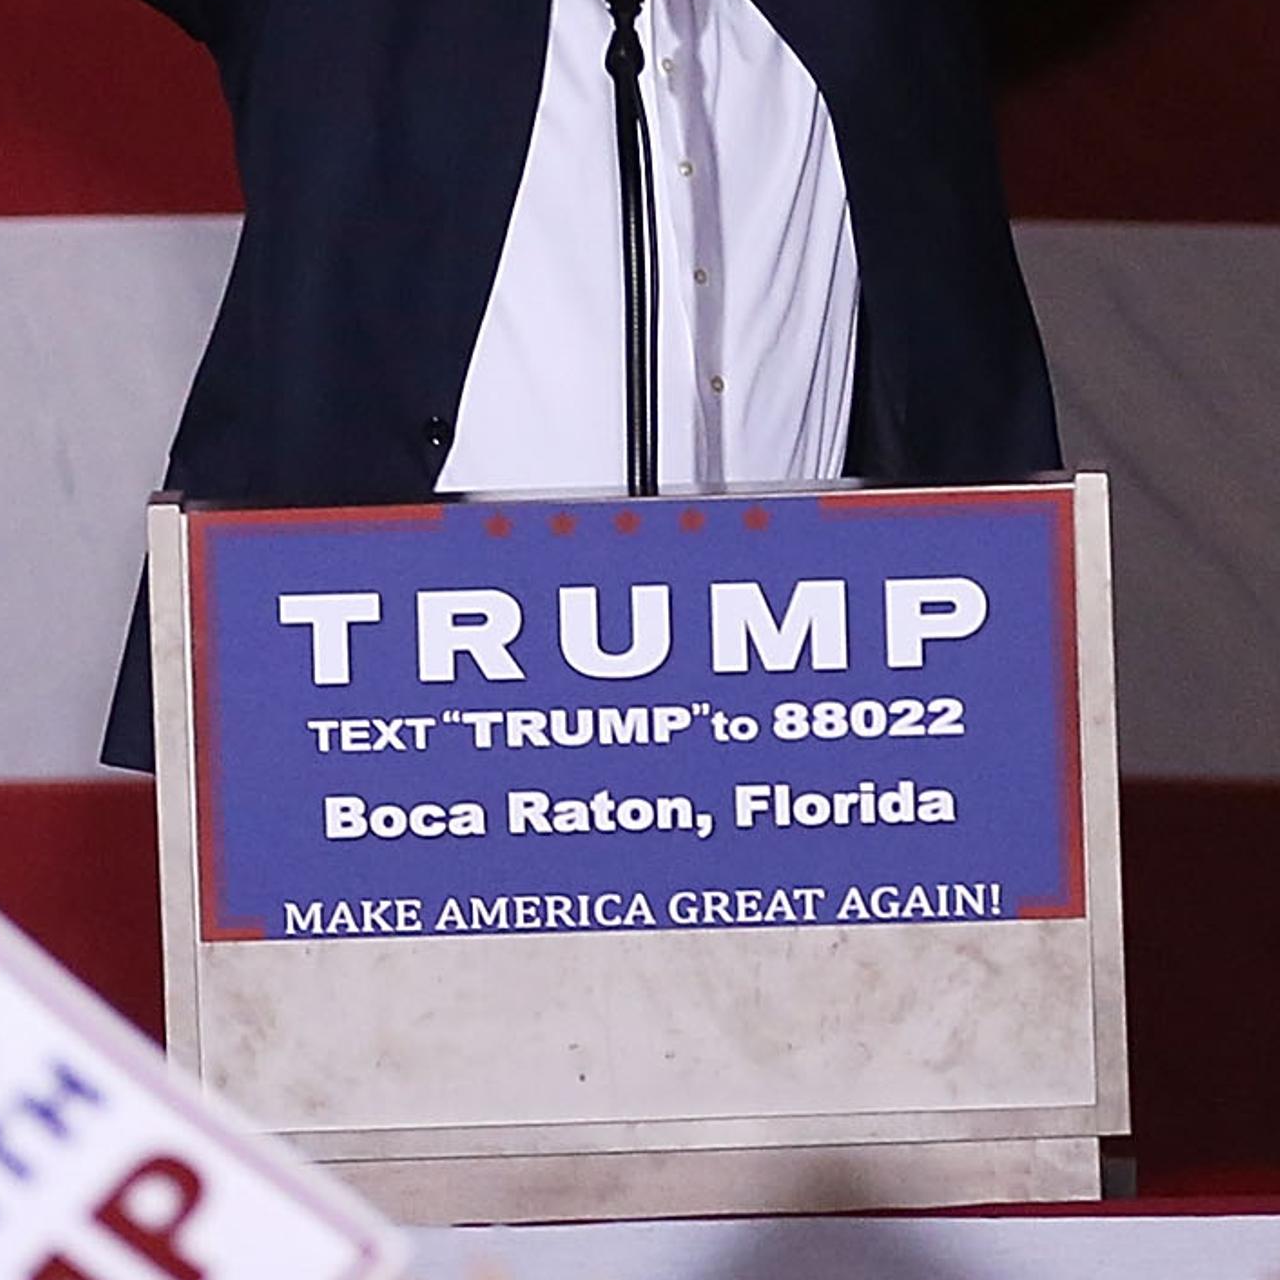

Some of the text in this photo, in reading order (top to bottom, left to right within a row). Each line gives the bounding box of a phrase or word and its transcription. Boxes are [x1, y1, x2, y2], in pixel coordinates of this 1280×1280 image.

[278, 577, 988, 686] TRUMP
[307, 717, 437, 753] TEXT
[711, 710, 759, 742] to
[772, 697, 966, 740] 88022
[324, 780, 956, 840] Boca Raton, Florida
[283, 883, 1003, 935] MAKE AMERICA GREAT AGAIN!
